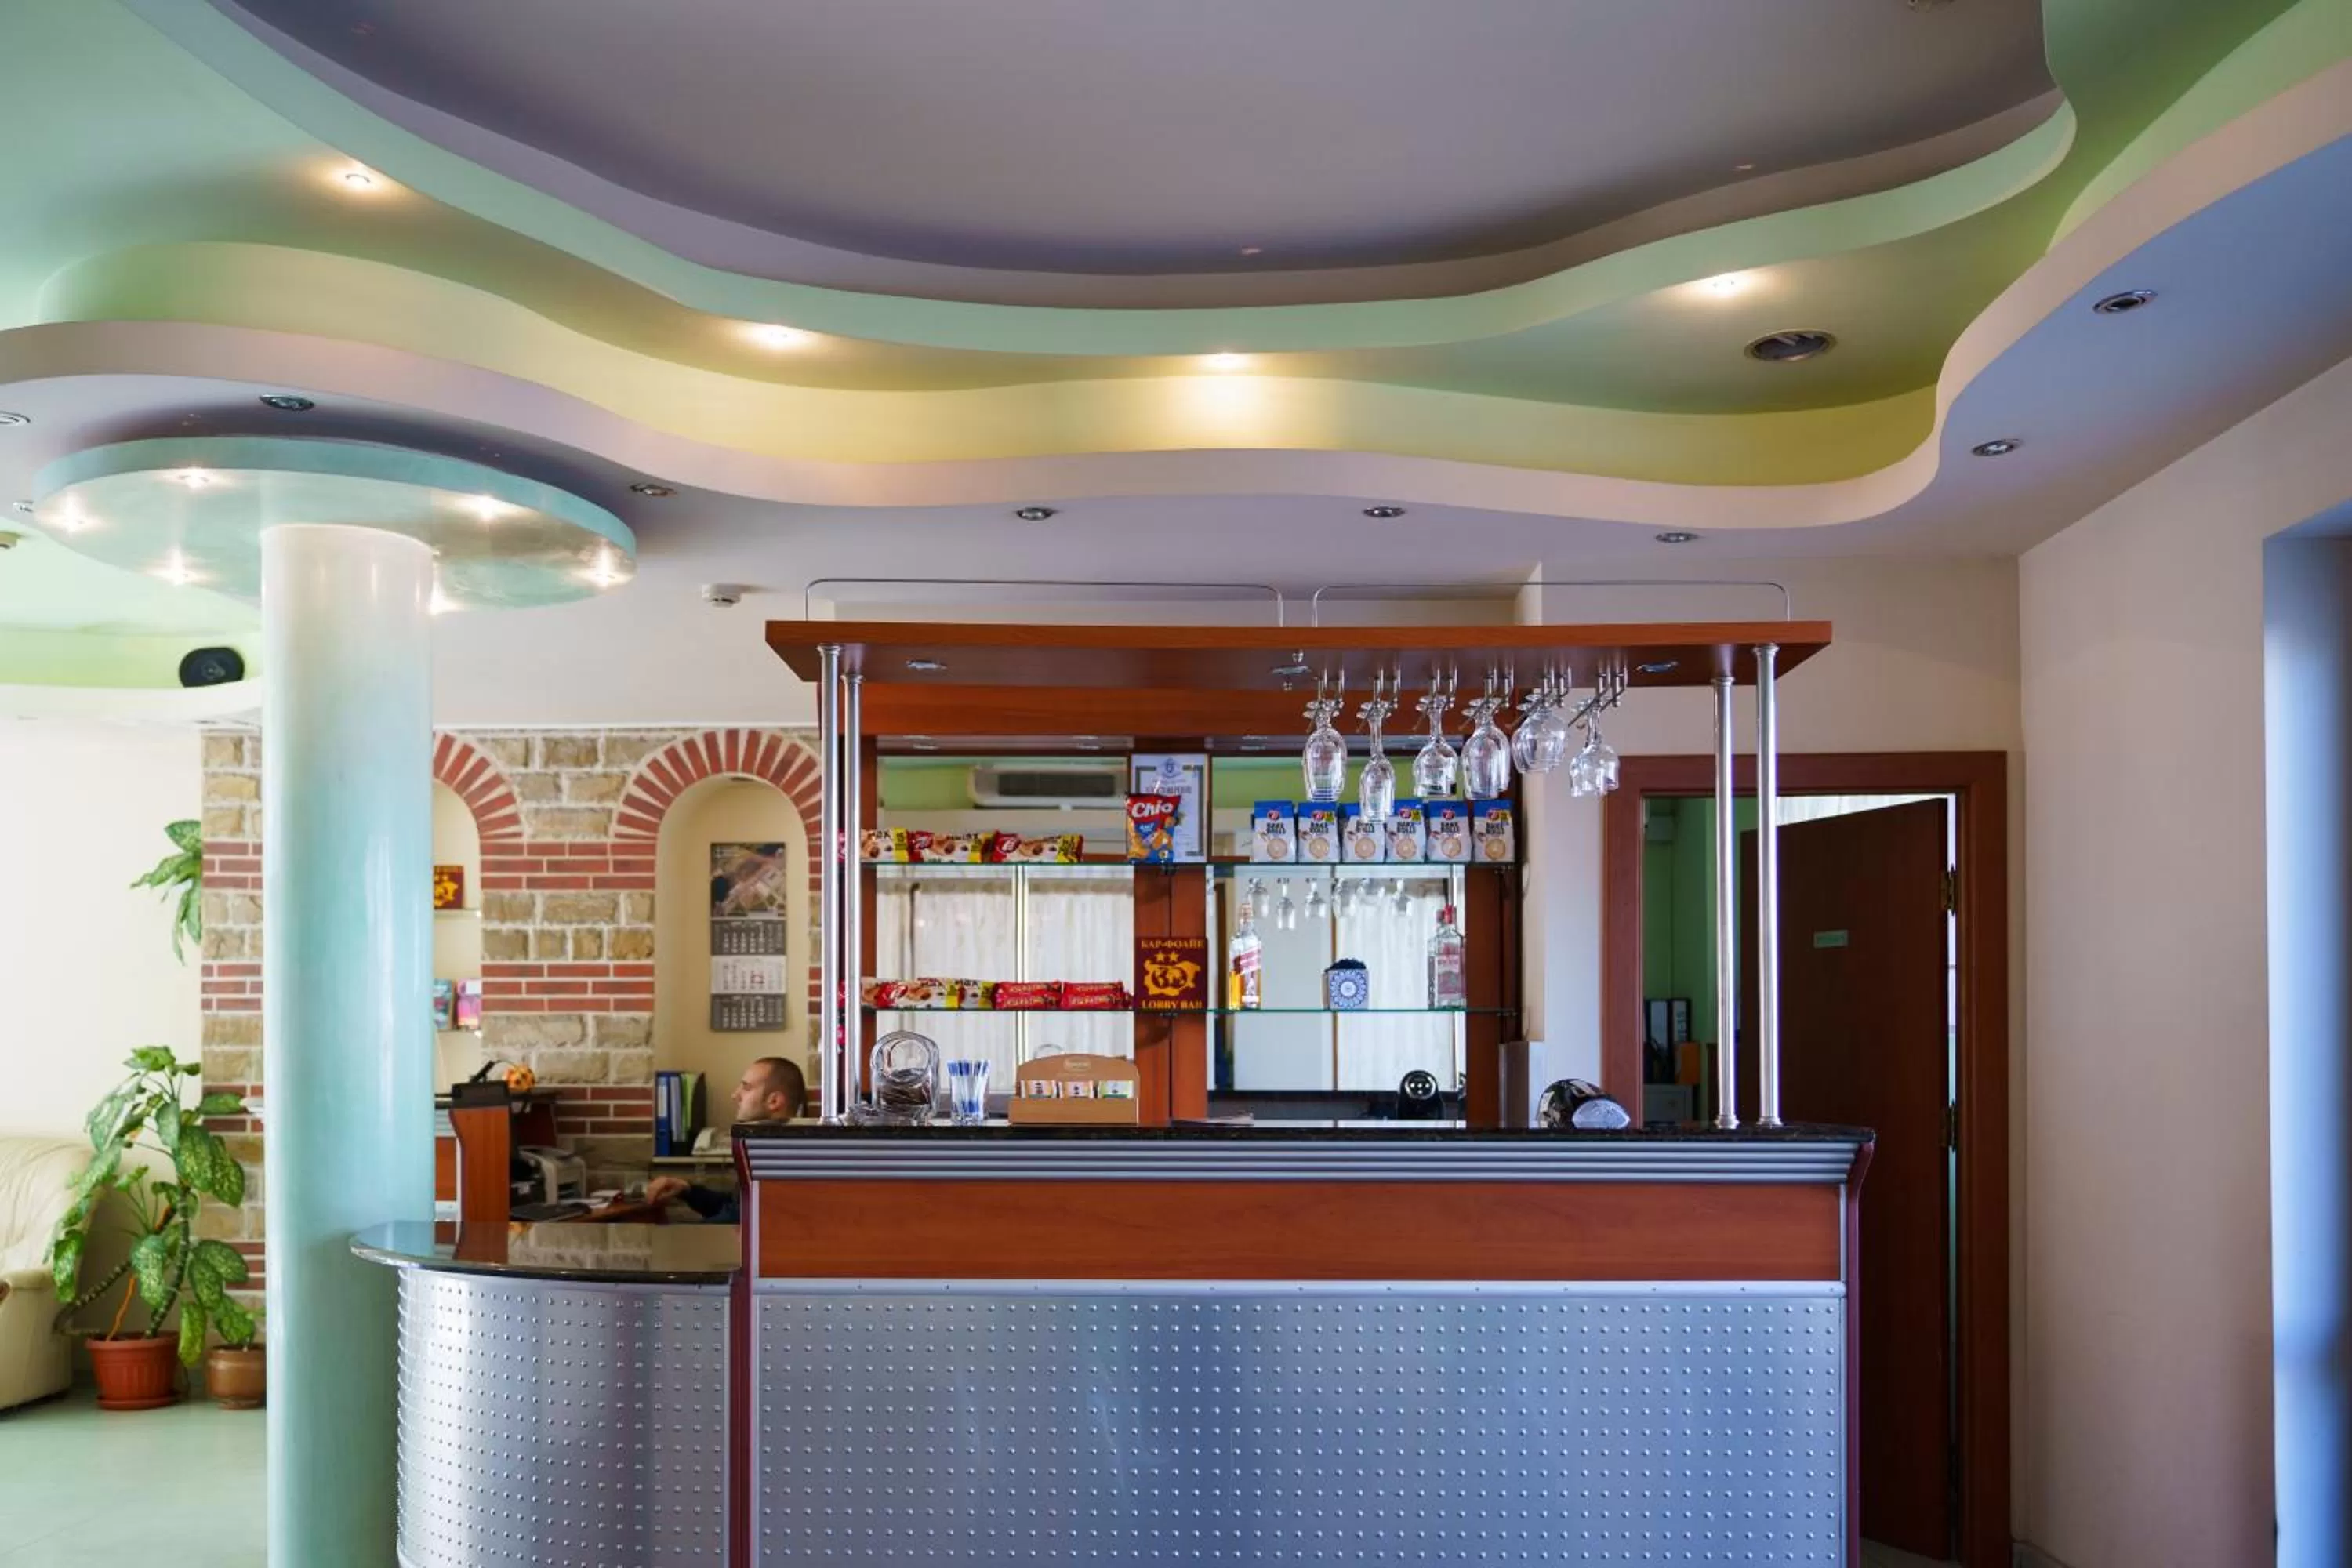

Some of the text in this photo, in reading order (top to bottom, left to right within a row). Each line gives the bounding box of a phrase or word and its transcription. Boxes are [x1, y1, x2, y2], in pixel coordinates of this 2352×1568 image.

[1131, 800, 1174, 818] Chio
[1142, 1000, 1203, 1009] LOBBY BAR
